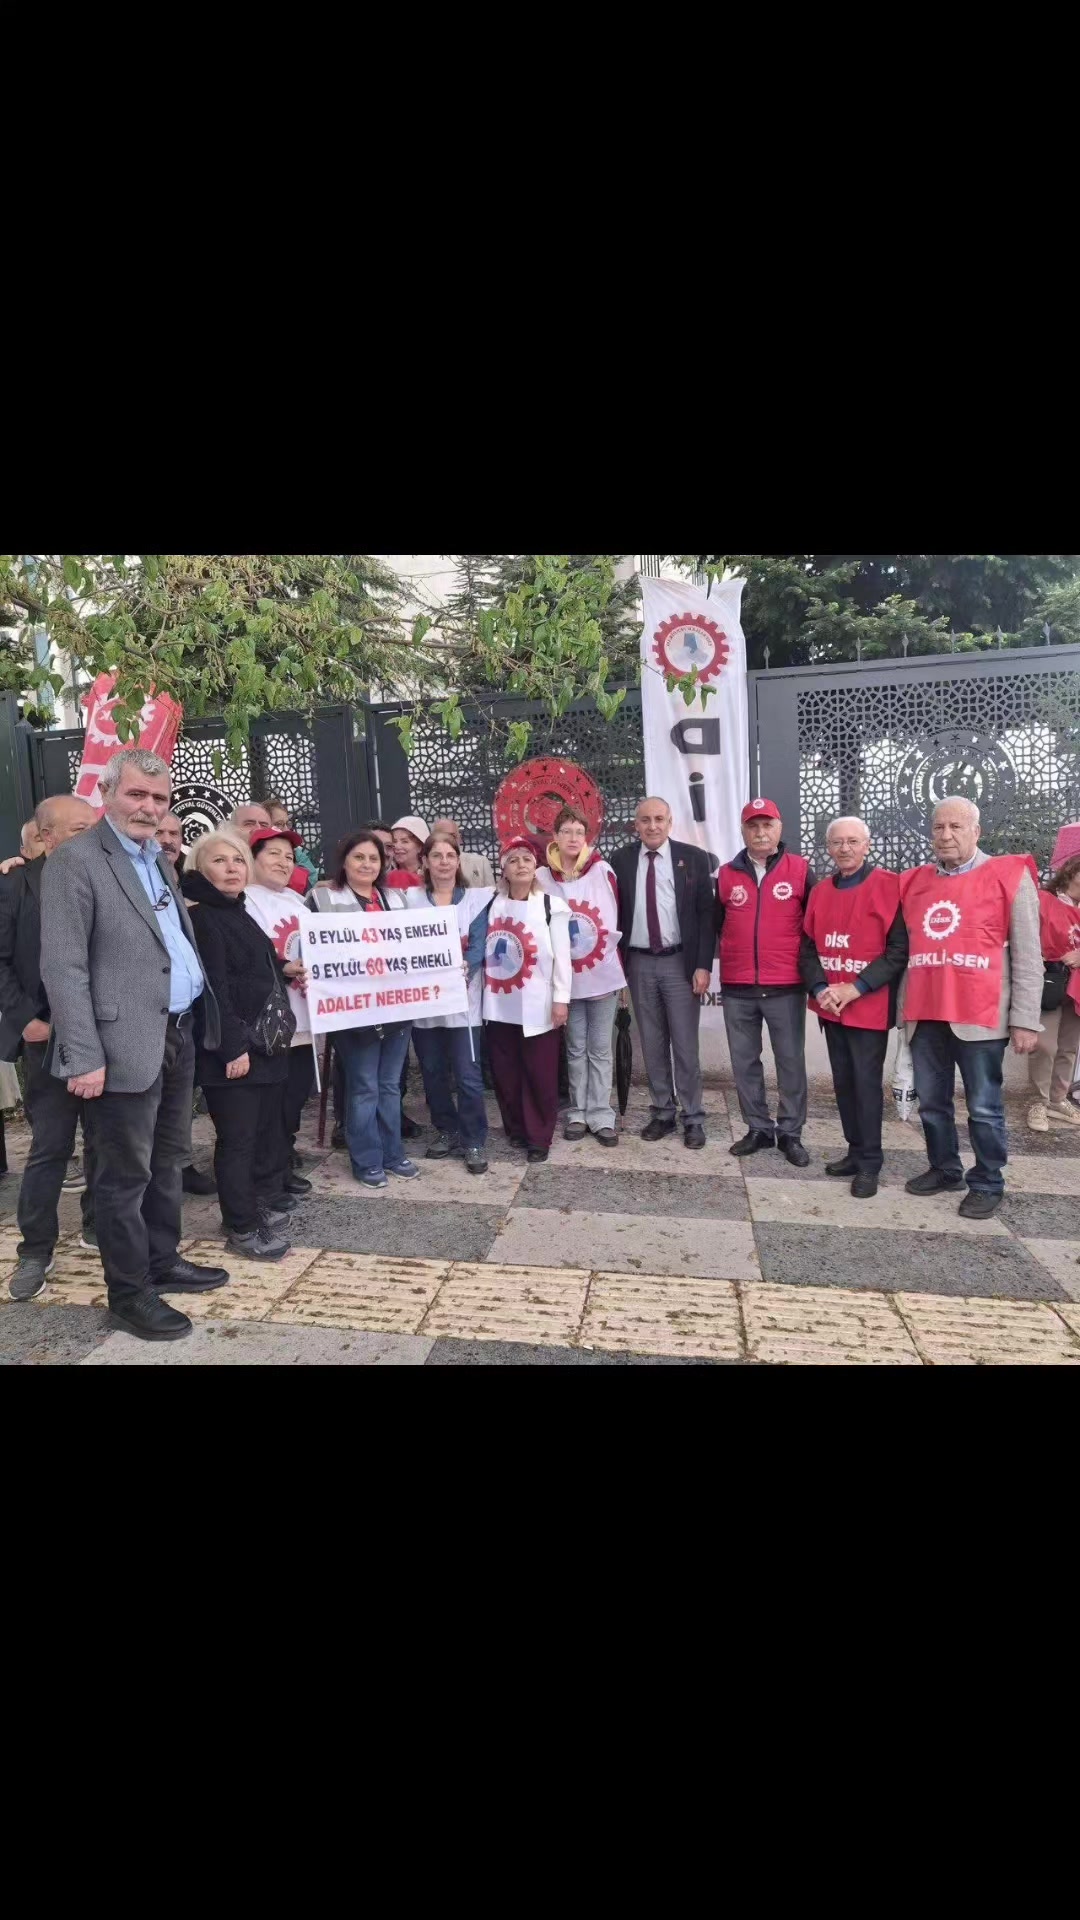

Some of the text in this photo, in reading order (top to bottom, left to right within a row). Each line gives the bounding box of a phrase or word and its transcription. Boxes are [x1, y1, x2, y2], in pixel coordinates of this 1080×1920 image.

[174, 801, 195, 814] SOSYAL
[308, 931, 317, 945] 8
[320, 927, 361, 945] EYLÜL
[361, 927, 379, 944] 43
[379, 927, 402, 943] YAŞ
[405, 920, 448, 939] EMEKLİ
[825, 930, 850, 948] DİSK
[312, 949, 453, 980] 9 EYLÜL 60 YAŞ EMEKLİ
[317, 985, 441, 1015] ADALET NEREDE ?
